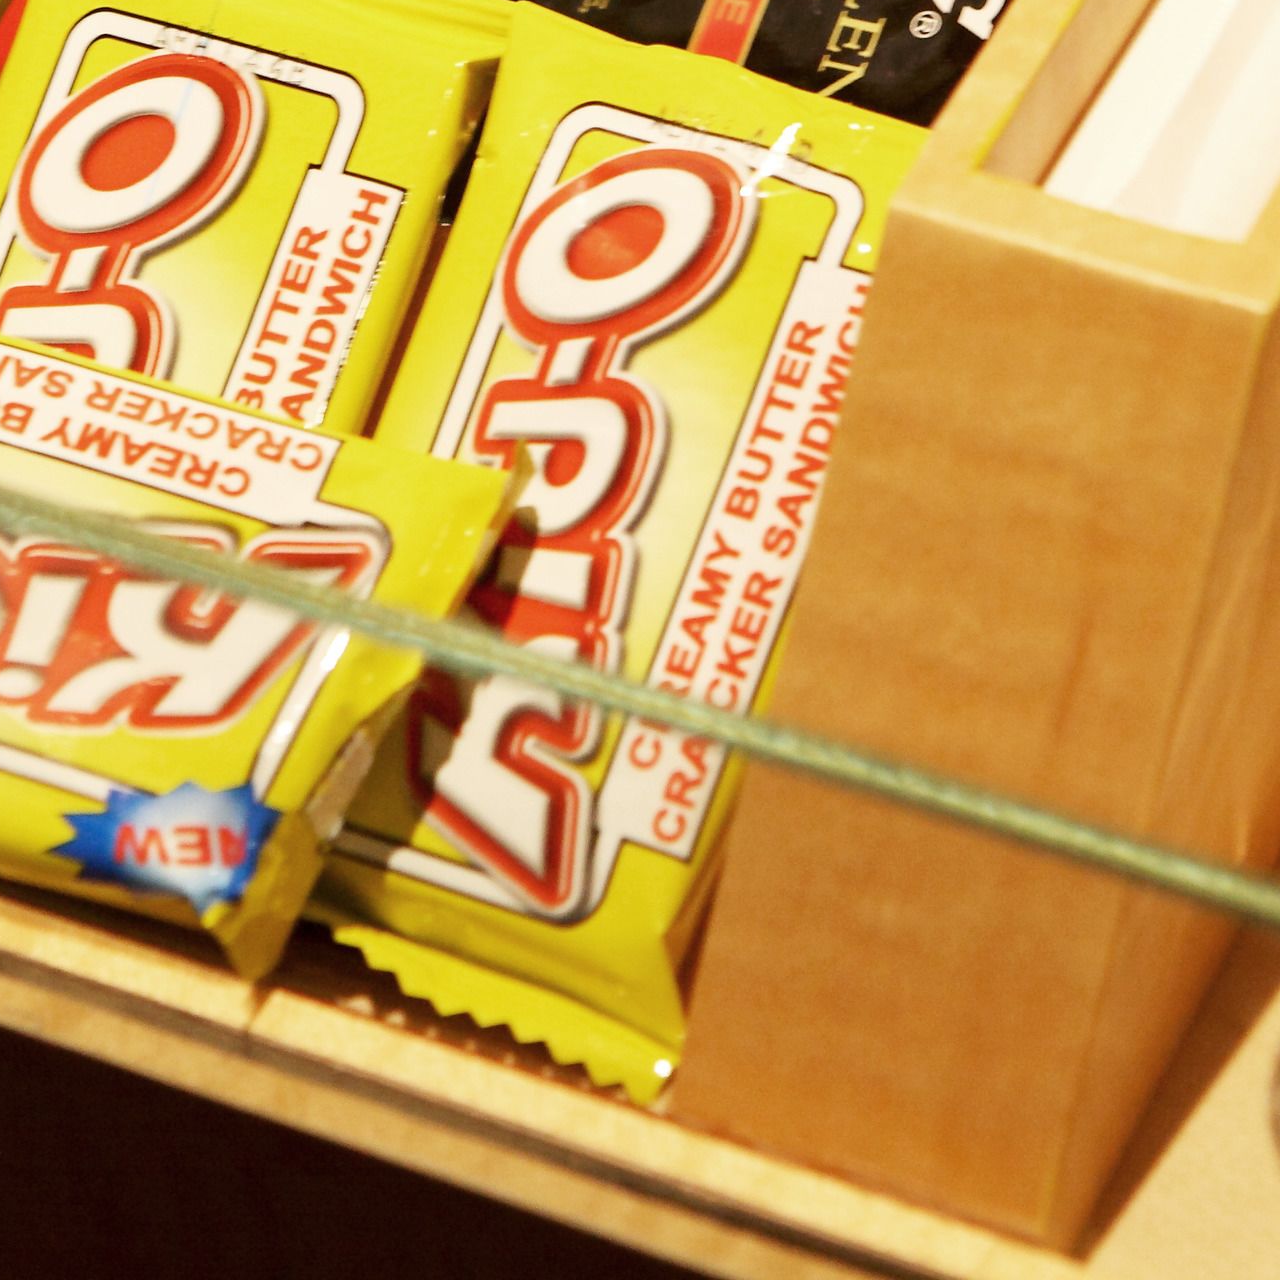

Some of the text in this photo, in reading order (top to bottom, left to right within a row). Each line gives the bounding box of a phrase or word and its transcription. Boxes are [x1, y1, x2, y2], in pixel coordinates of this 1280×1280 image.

[278, 188, 389, 423] ANDWICH
[40, 417, 253, 498] CREAMY
[84, 378, 324, 473] CRACKER
[726, 319, 826, 523] BUTTER
[112, 822, 250, 868] NEW
